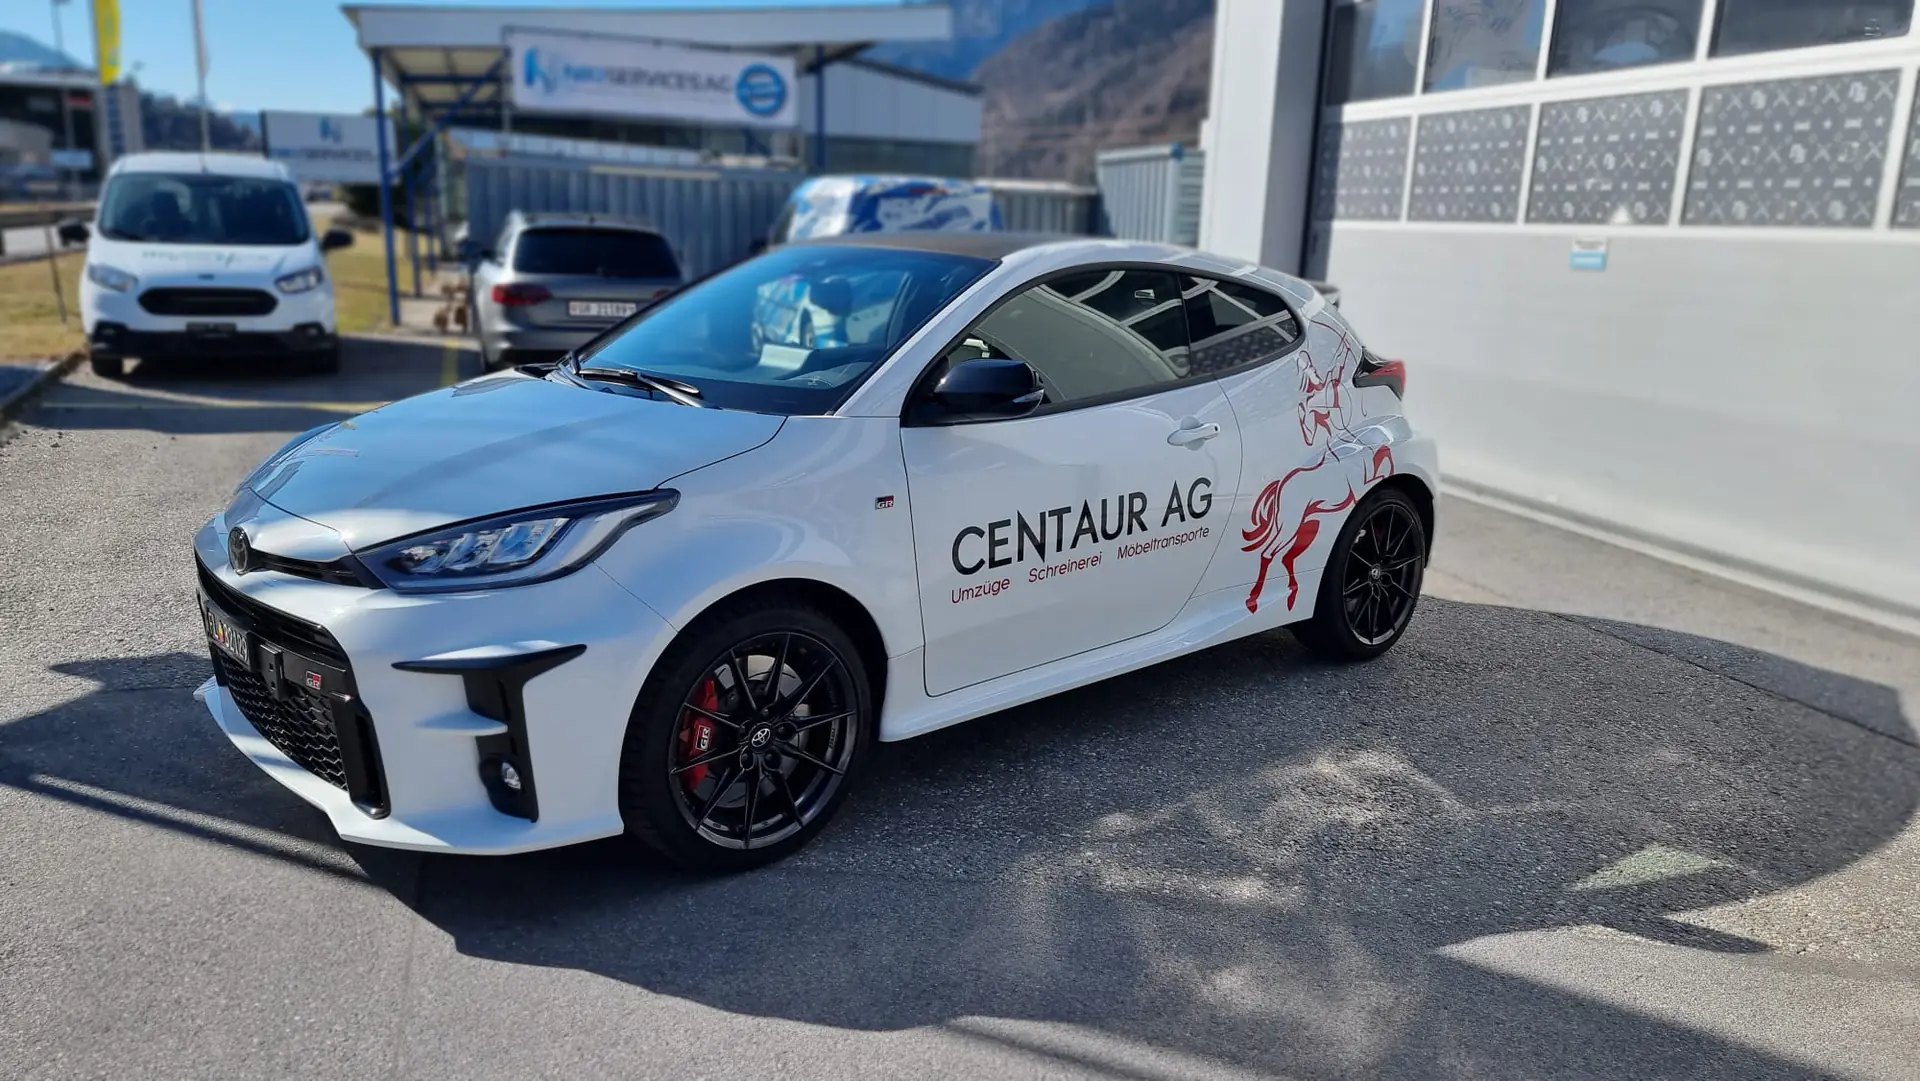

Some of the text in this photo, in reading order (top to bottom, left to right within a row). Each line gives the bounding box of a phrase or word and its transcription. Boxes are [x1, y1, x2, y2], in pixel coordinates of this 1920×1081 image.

[951, 477, 1213, 575] CENTAUR AG
[951, 526, 1210, 604] Umzüge Schreinerei Möbeltransporte
[700, 726, 710, 750] GR
